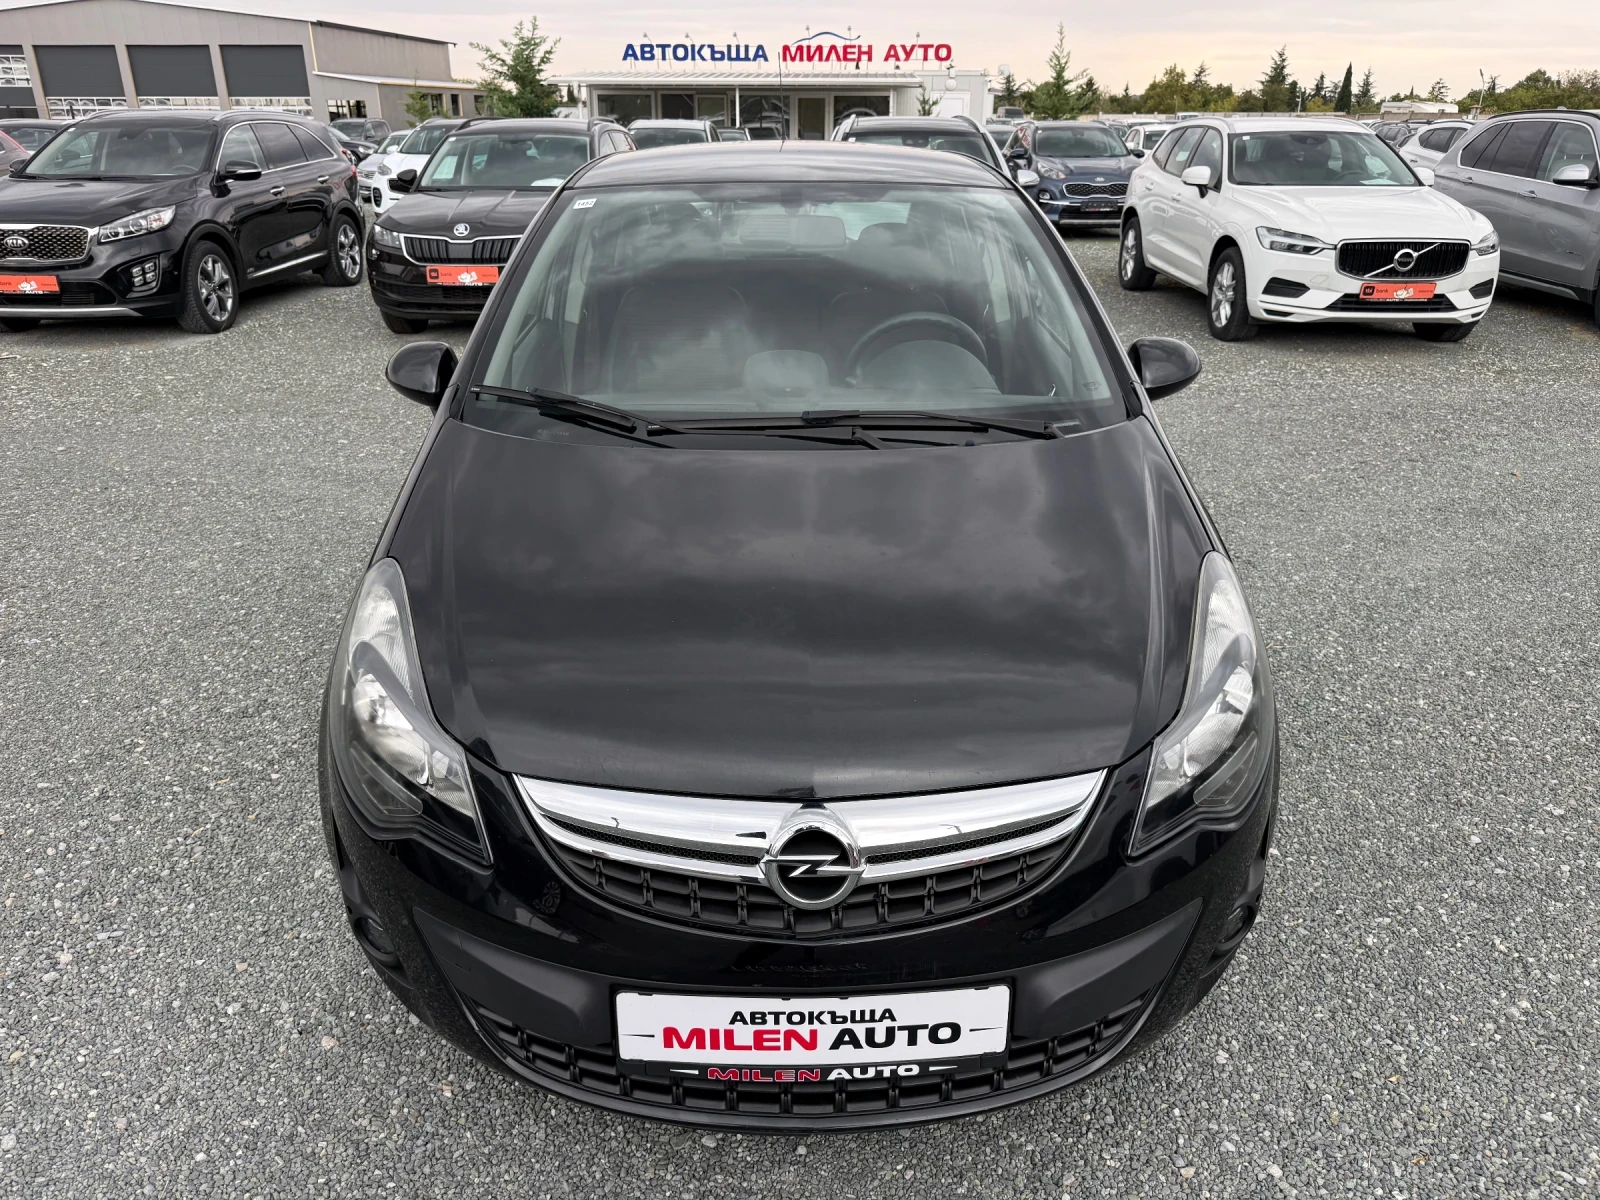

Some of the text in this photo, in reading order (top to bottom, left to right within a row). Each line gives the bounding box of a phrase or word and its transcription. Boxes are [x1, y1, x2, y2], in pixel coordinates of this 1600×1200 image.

[622, 43, 952, 63] АВТОКЪЩА МИЛЕН АУТО
[729, 1008, 897, 1026] АВТОКЪЩА
[662, 1022, 962, 1052] MILEN AUTO
[707, 1064, 920, 1083] MILEN AUTO
